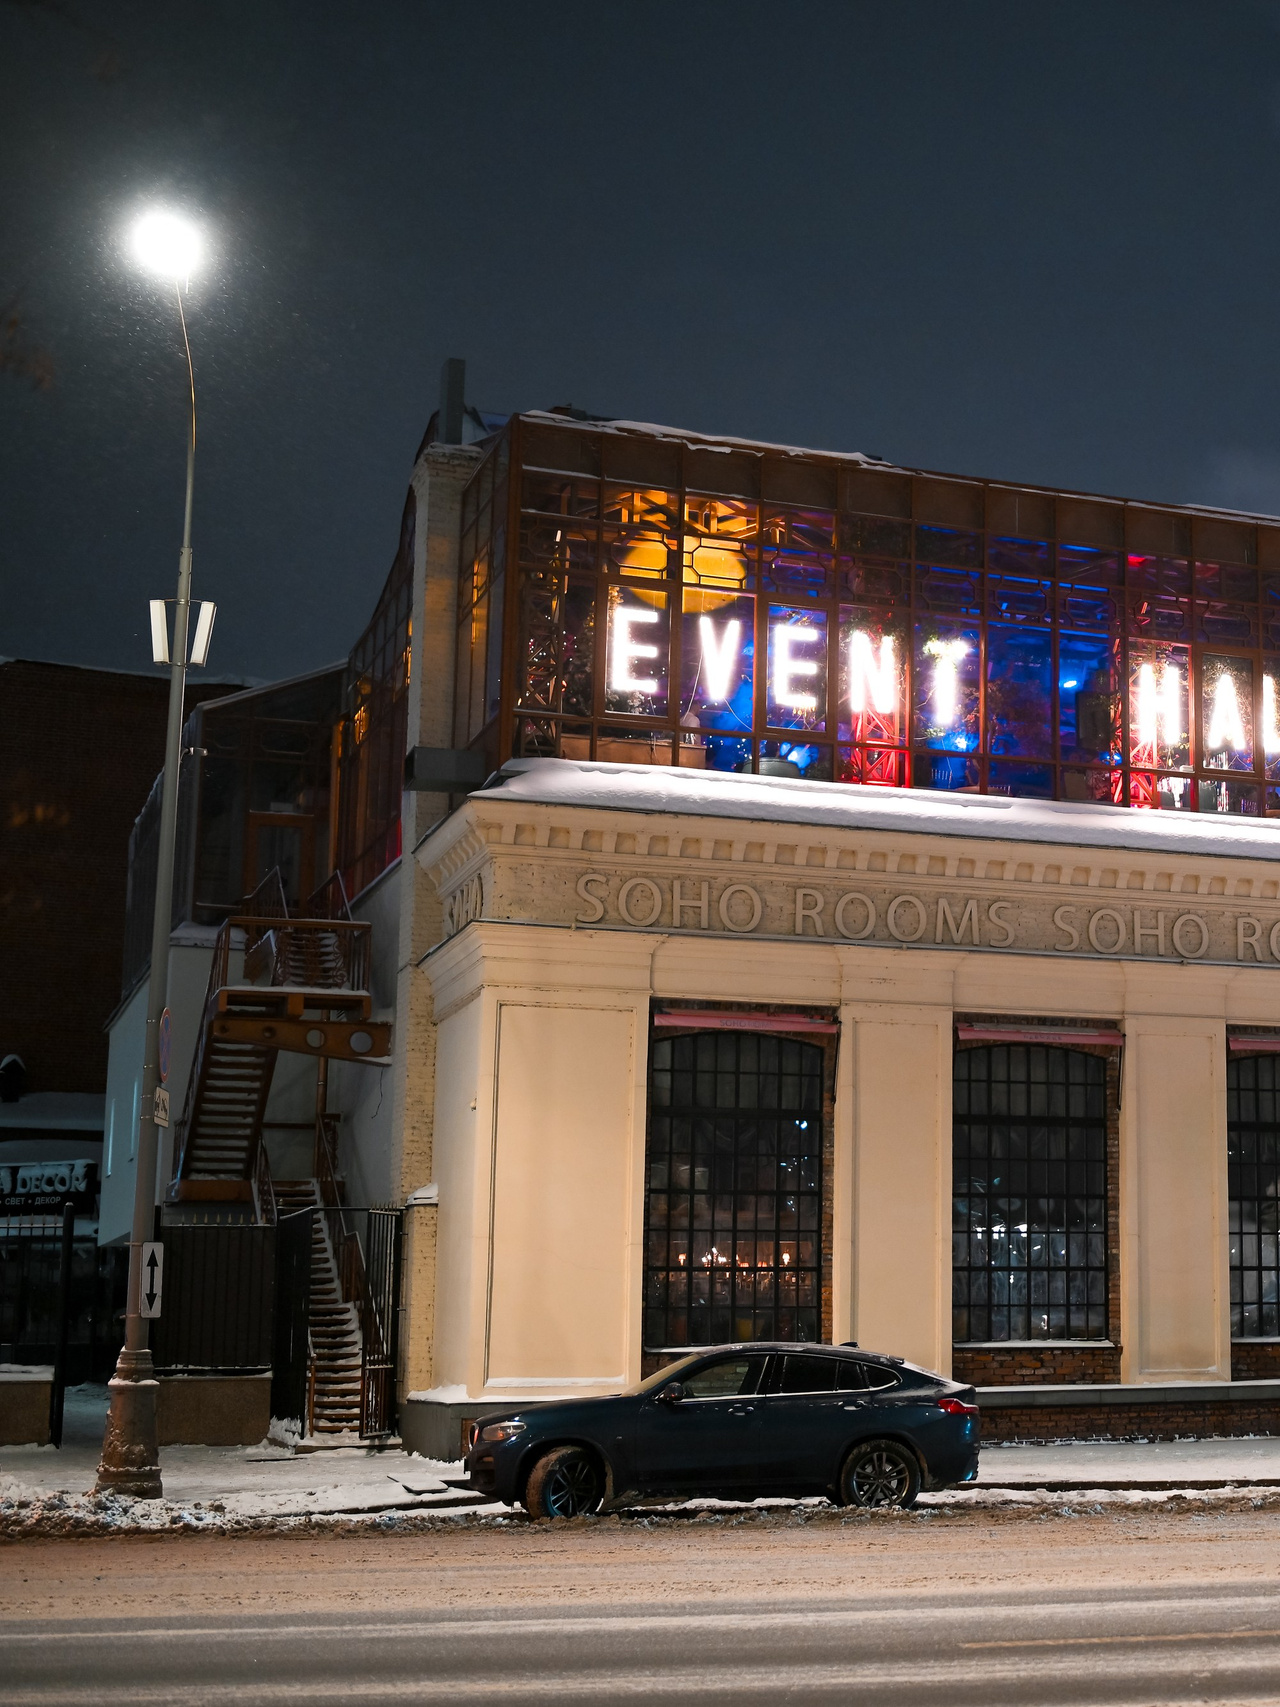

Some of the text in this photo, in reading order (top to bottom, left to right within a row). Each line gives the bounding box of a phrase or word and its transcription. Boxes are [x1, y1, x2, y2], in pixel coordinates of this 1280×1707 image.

[612, 606, 970, 725] EVENT
[575, 872, 763, 933] SOHO
[795, 887, 1016, 948] ROOMS
[1052, 905, 1210, 959] SOHO
[5, 1196, 61, 1206] СВЕТ ДЕКОР
